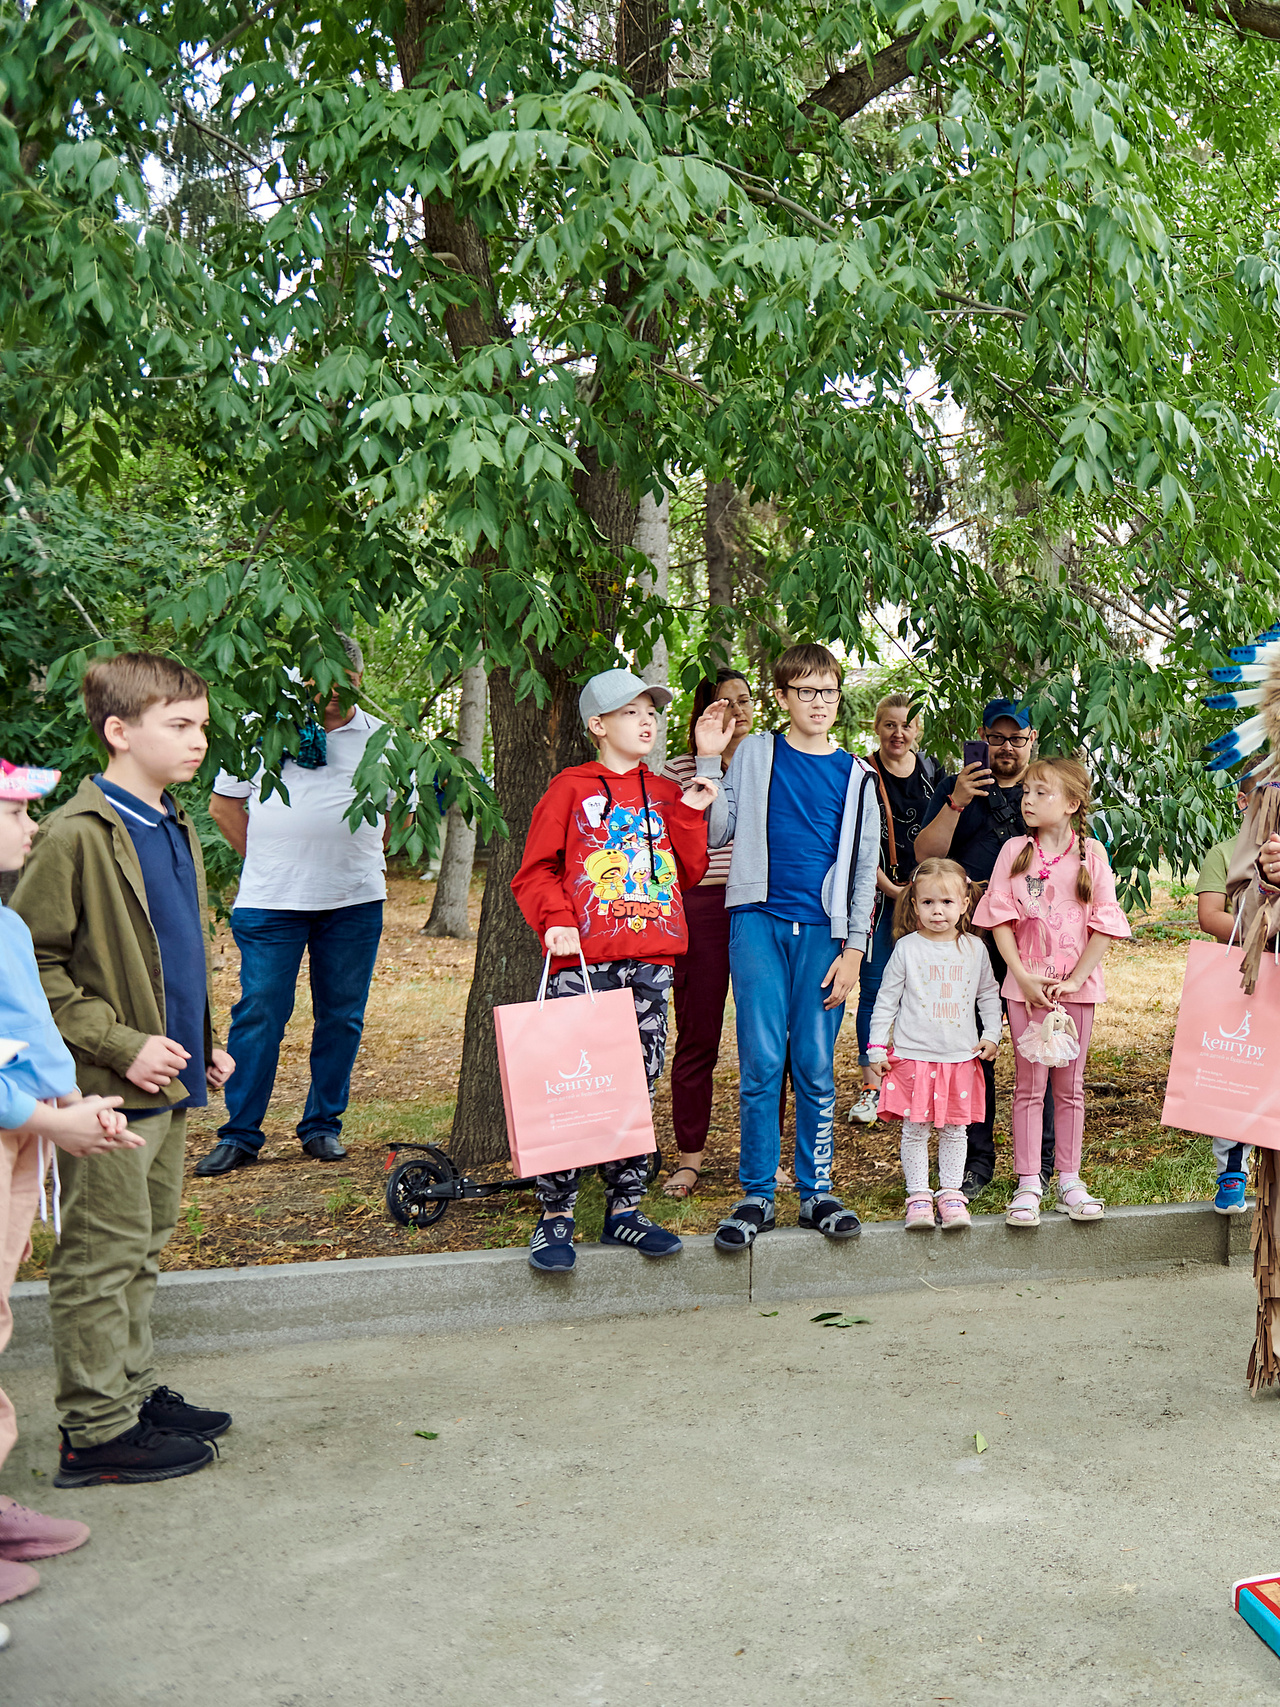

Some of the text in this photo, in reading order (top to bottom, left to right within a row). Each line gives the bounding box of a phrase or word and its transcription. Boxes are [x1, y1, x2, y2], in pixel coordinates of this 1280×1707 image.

[612, 899, 660, 919] STARS
[929, 965, 964, 982] JUST CUTE
[940, 983, 953, 999] AND
[933, 1002, 961, 1019] FAMOUS
[1202, 1032, 1266, 1060] кенгуру
[545, 1073, 614, 1096] кенгуру
